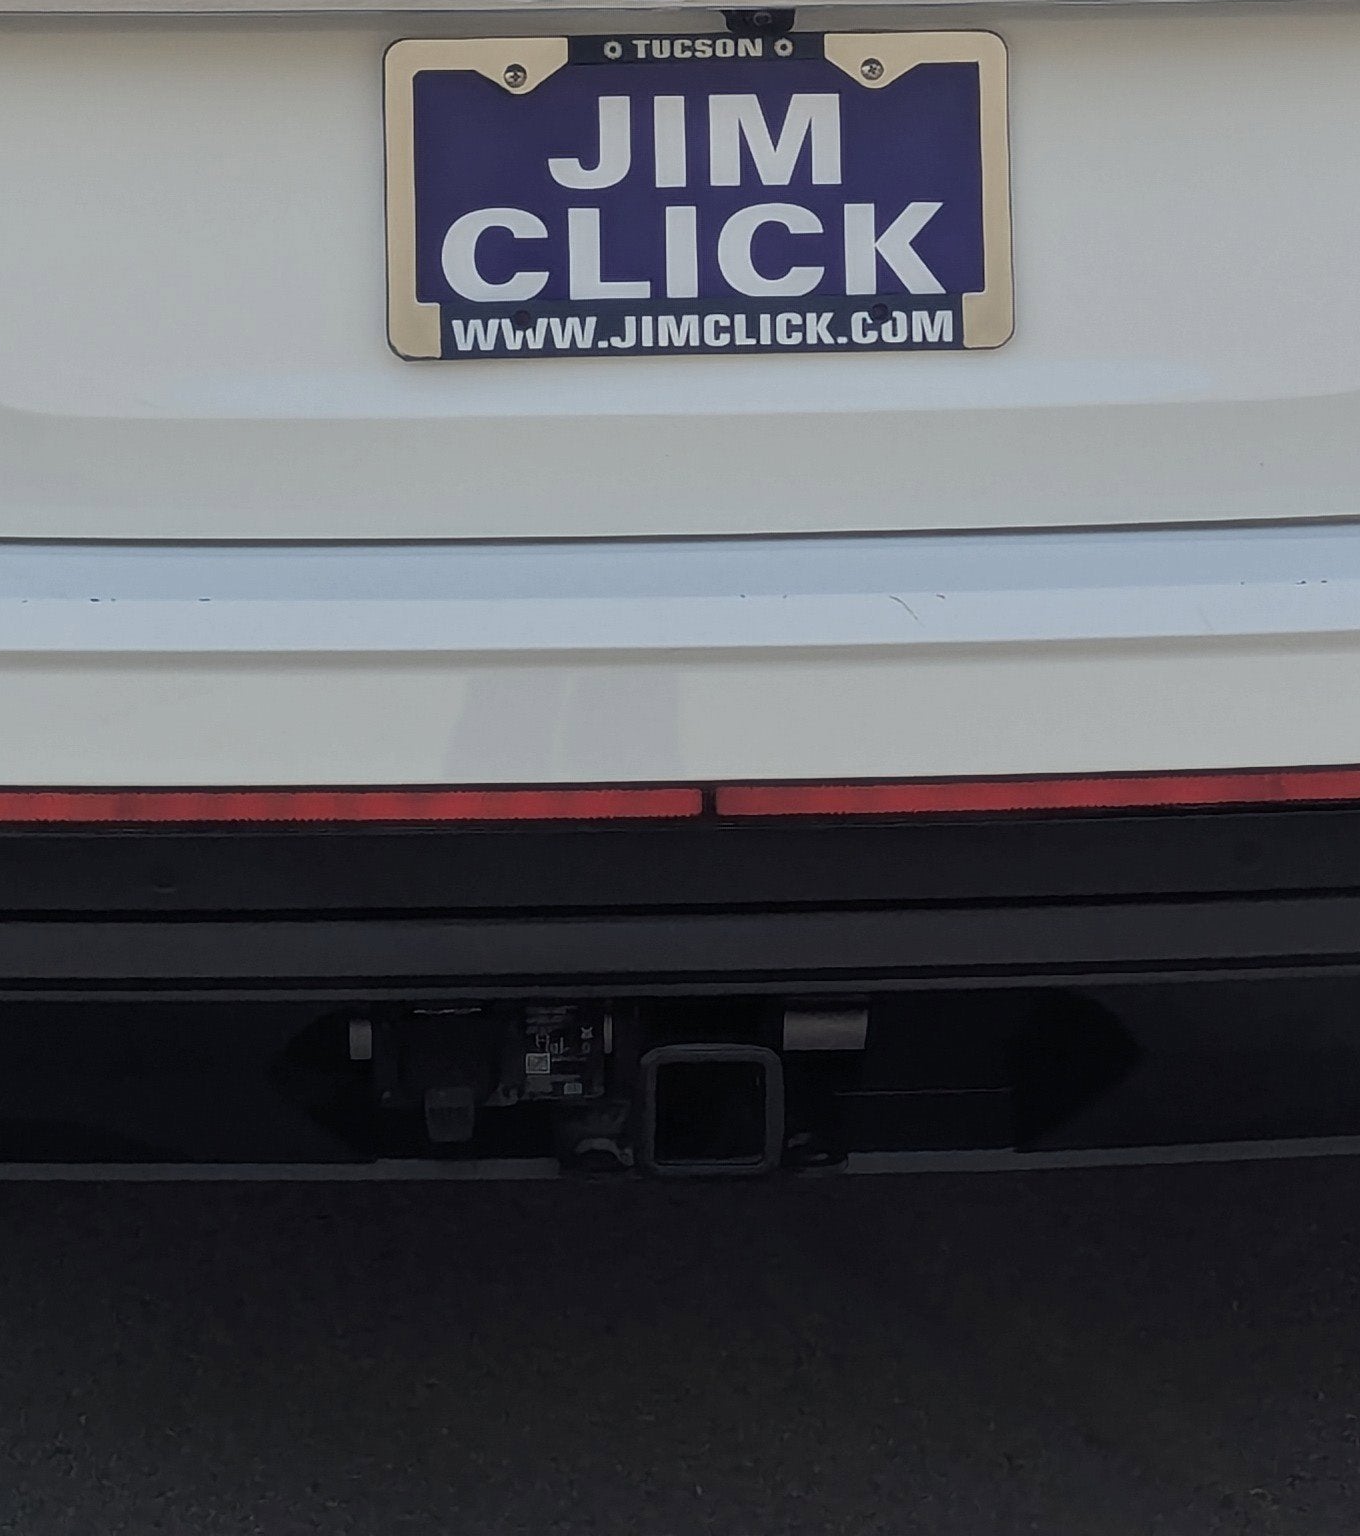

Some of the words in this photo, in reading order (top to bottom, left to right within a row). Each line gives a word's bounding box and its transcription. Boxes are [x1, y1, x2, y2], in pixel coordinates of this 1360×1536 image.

[632, 37, 763, 59] TUCSON
[547, 93, 842, 190] JIM
[440, 201, 948, 303] CLICK
